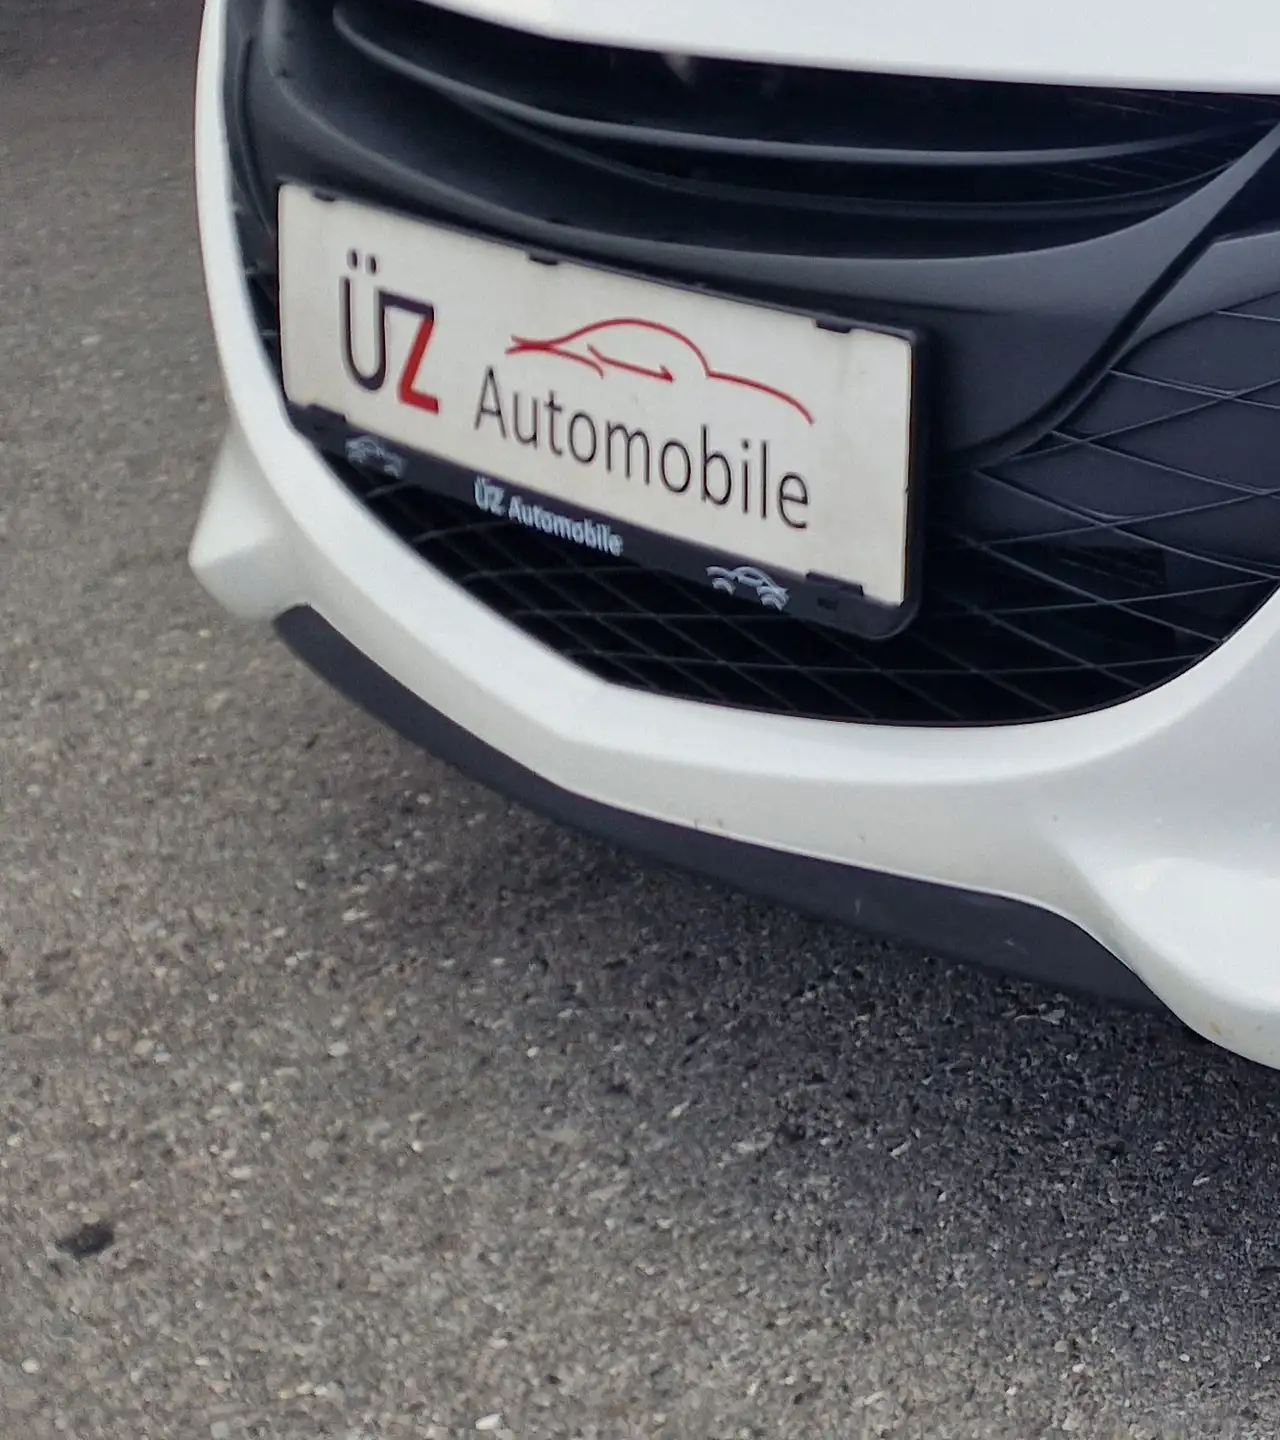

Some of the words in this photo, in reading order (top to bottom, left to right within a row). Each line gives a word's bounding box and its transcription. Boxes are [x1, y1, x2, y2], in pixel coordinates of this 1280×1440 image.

[339, 248, 440, 415] ÜZ
[474, 366, 809, 530] Automobile
[474, 476, 506, 517] ÜZ
[508, 495, 624, 557] Automobile
